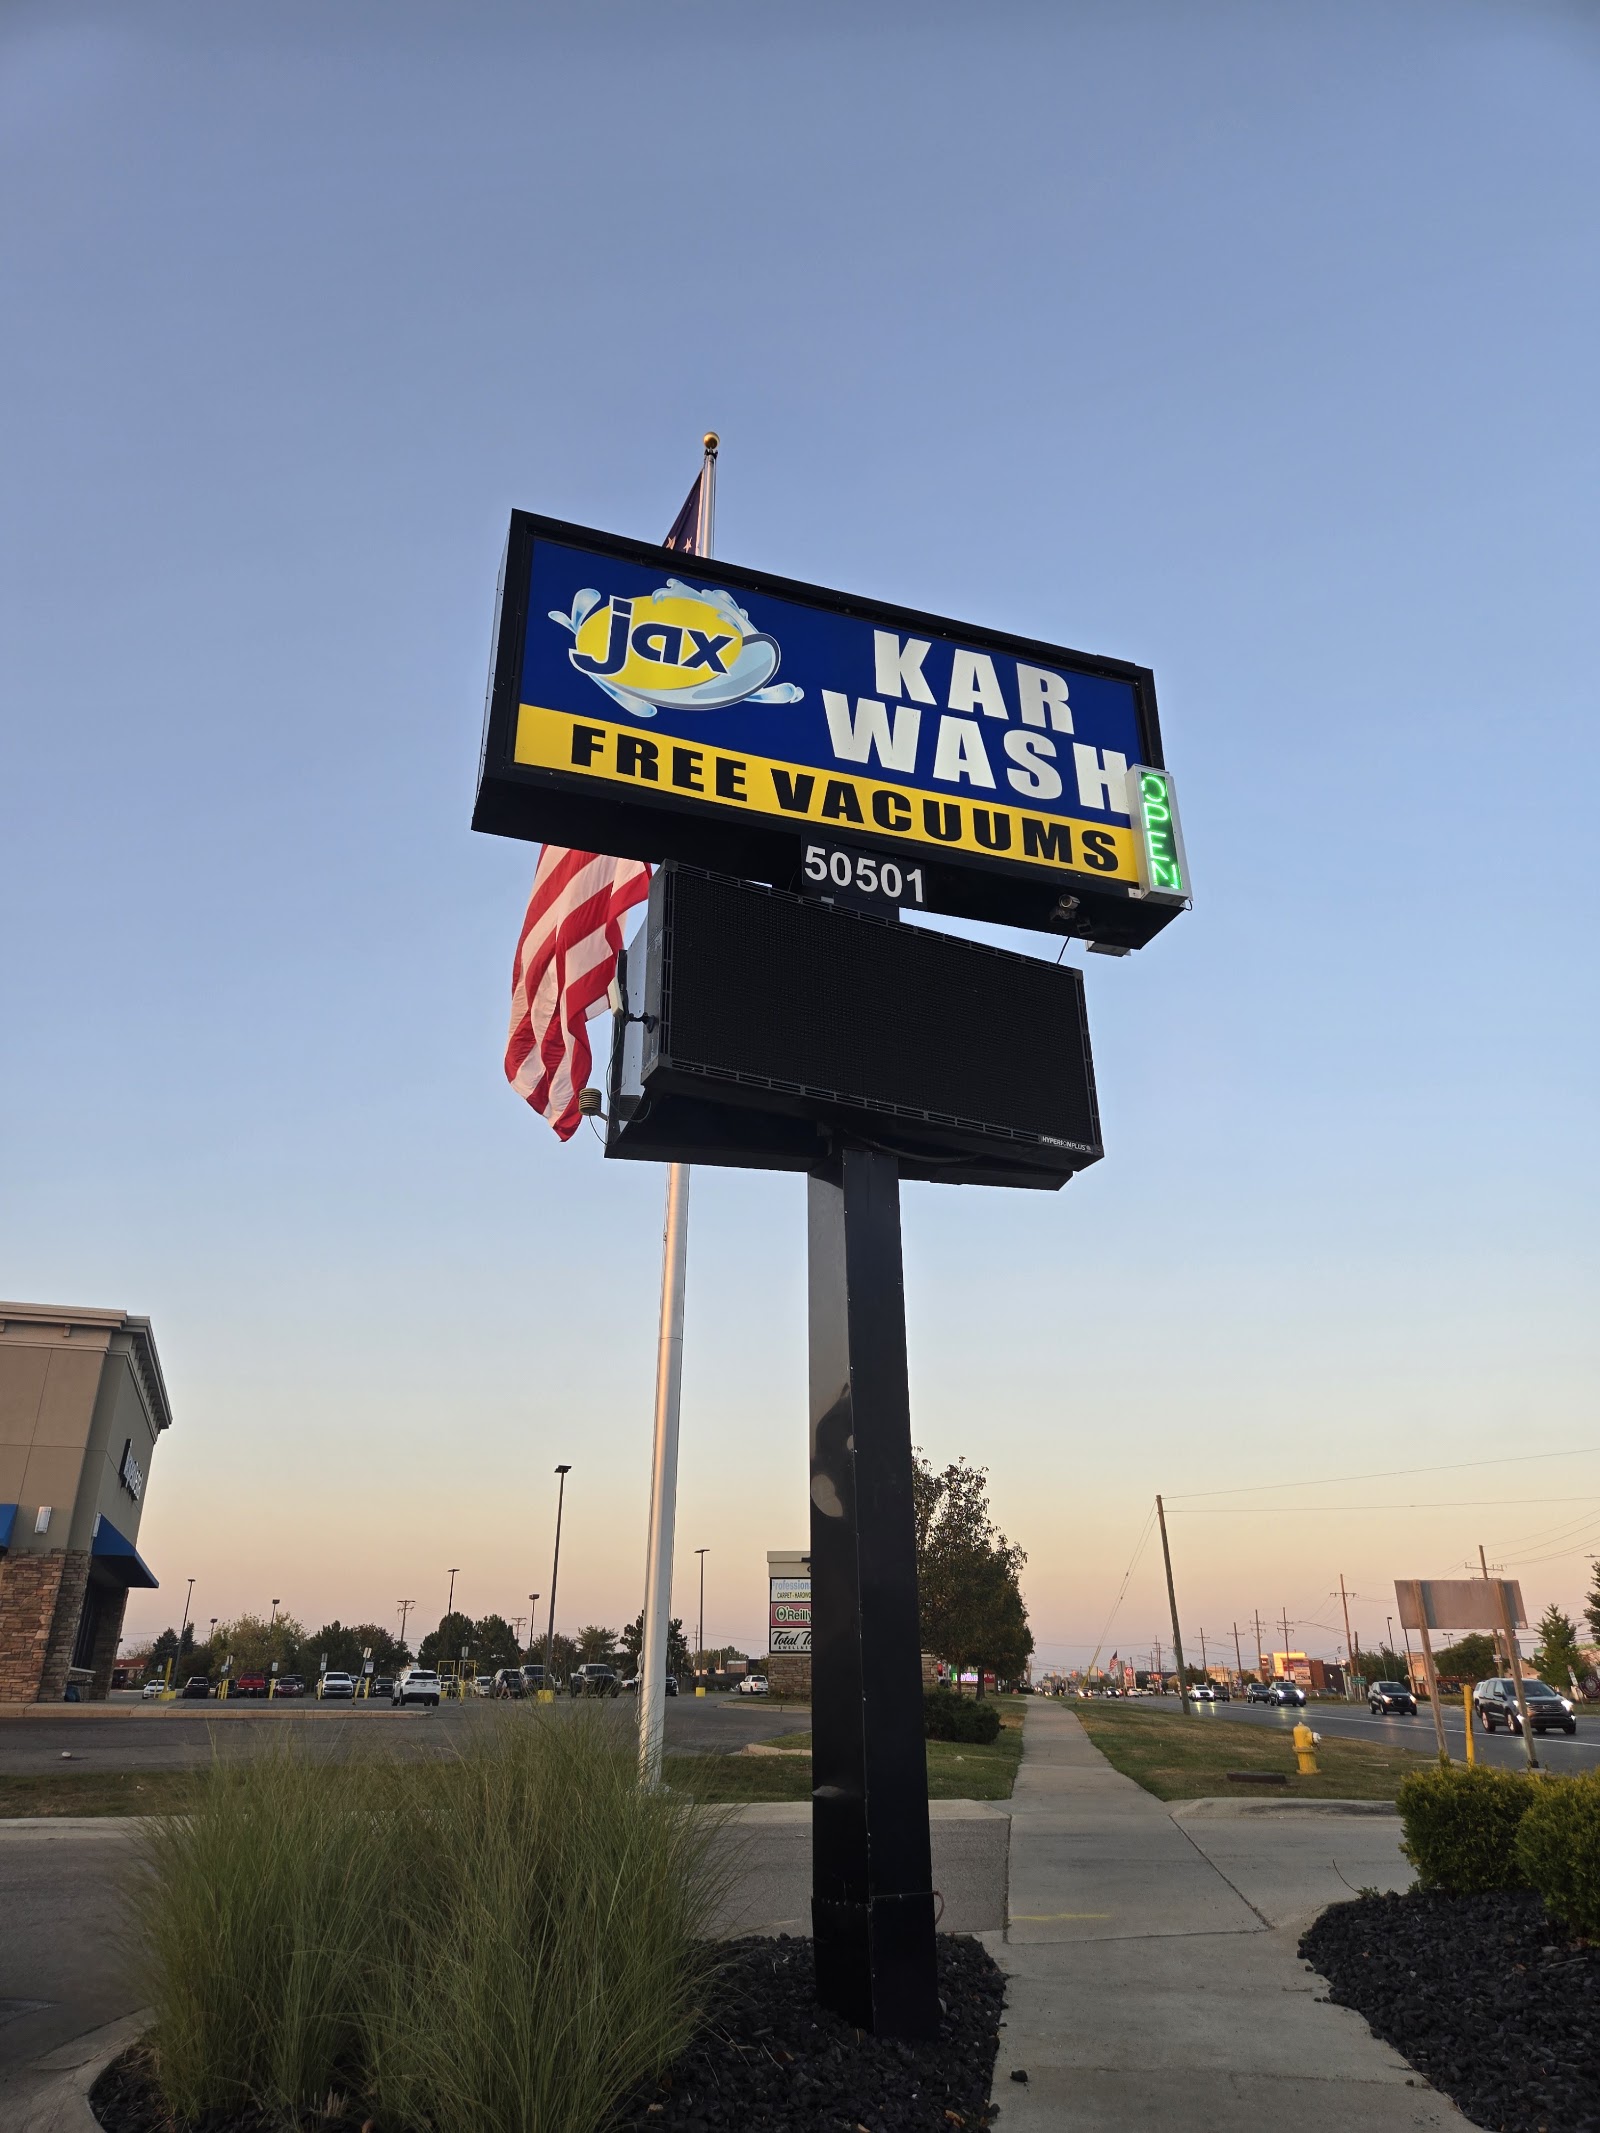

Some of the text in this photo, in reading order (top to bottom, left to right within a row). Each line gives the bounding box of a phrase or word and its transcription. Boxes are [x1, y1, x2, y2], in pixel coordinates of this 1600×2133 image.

[569, 595, 737, 676] jax
[874, 629, 1074, 735] KAR
[571, 724, 1119, 872] FREE VACUUMS
[822, 689, 1130, 814] WASH
[804, 845, 924, 903] 50501
[1141, 775, 1182, 890] OPEN
[772, 1630, 800, 1646] Total
